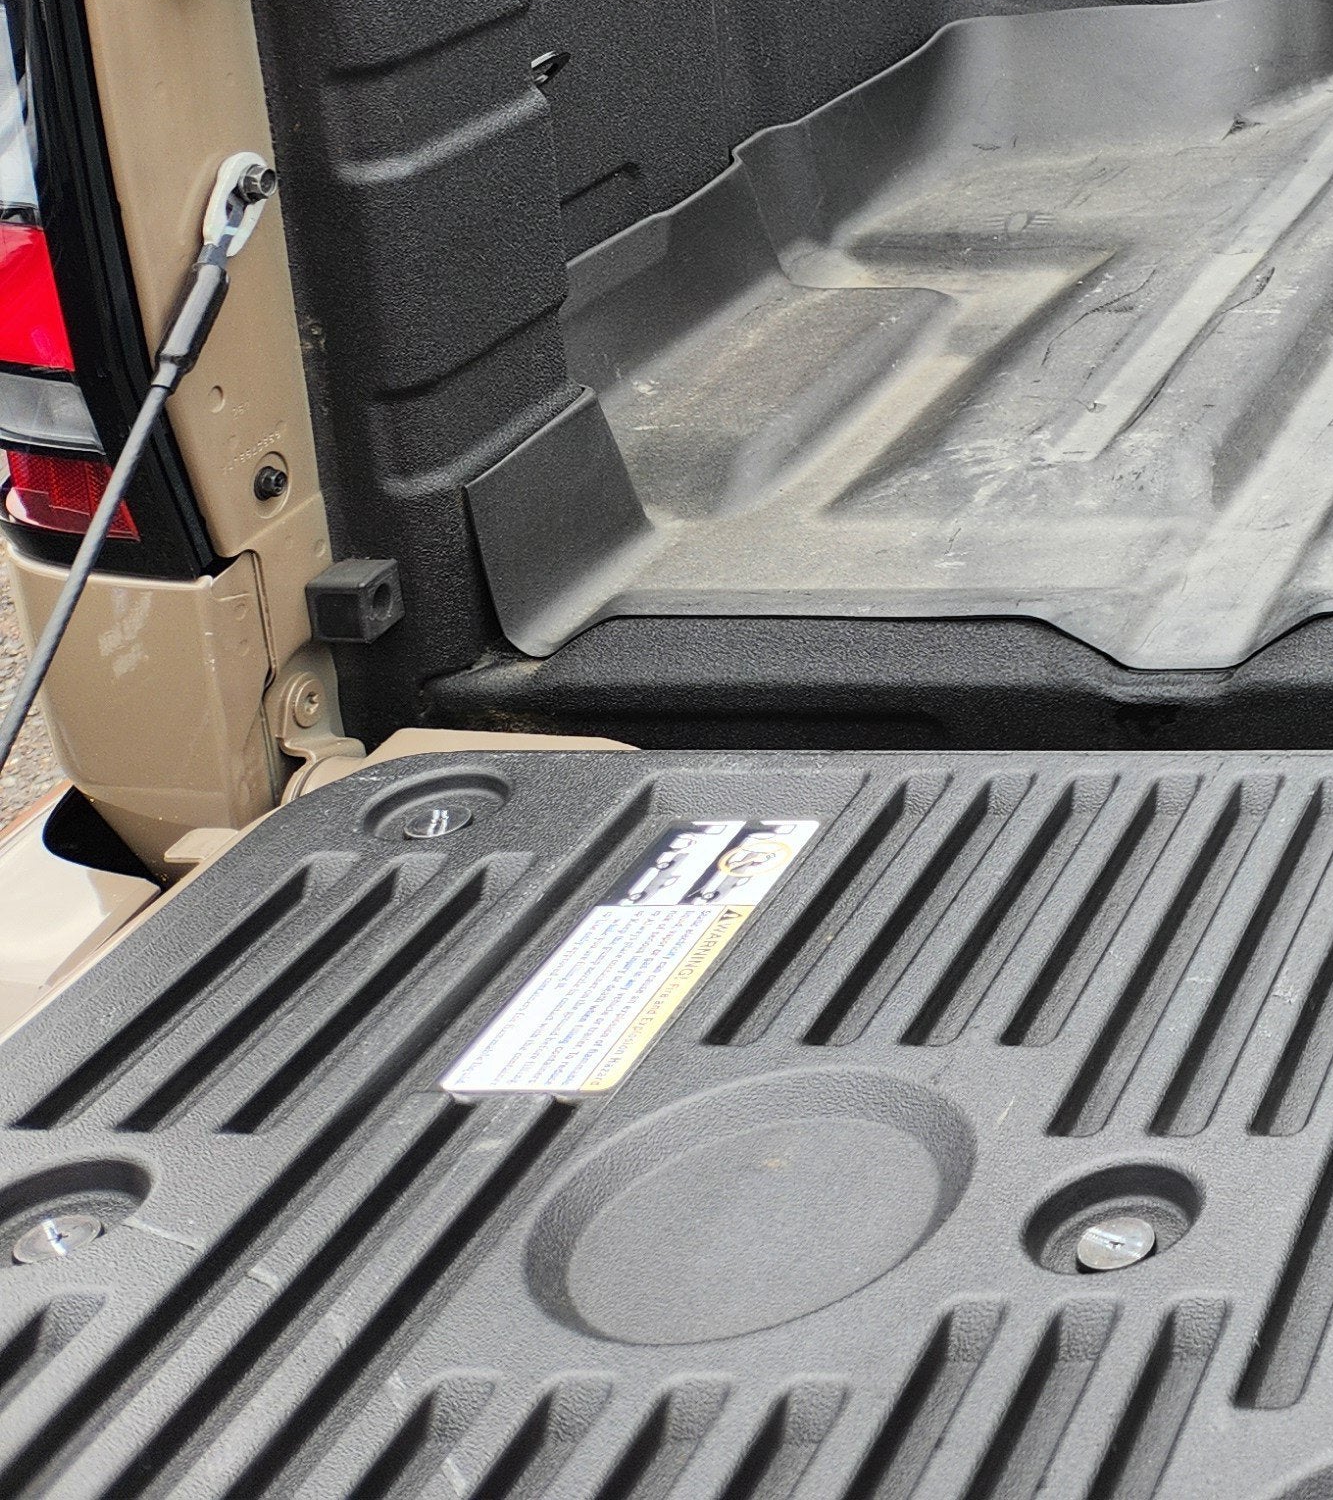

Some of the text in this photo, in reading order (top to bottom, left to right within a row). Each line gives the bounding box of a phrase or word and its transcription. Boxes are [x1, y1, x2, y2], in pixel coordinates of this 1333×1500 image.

[673, 923, 732, 979] WARNING!
[645, 1000, 665, 1014] and
[612, 1017, 653, 1054] Explosion
[588, 1057, 622, 1085] Hazard
